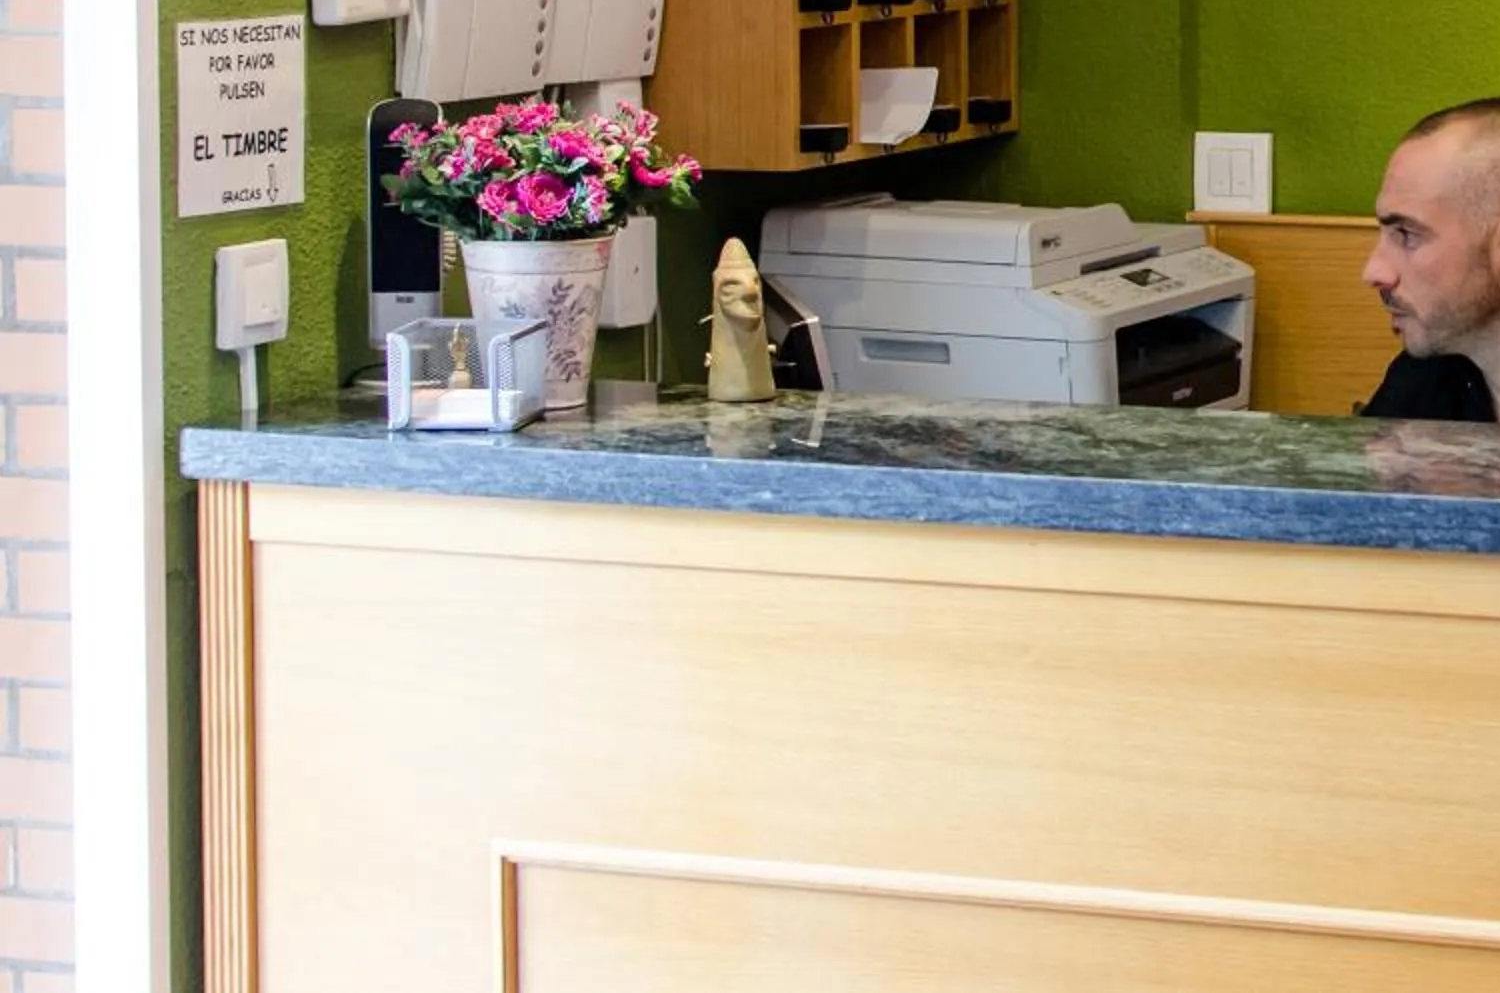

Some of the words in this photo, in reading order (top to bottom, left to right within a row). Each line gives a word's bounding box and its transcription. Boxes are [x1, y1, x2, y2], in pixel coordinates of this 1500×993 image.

[180, 29, 195, 46] SI
[201, 27, 228, 45] NOS
[233, 23, 301, 44] NECESITAN
[208, 54, 232, 73] POR
[237, 52, 275, 71] FAVOR
[219, 80, 265, 100] PULSEN
[193, 134, 215, 162] EL
[221, 126, 289, 158] TIMBRE
[221, 188, 262, 204] GRACIAS
